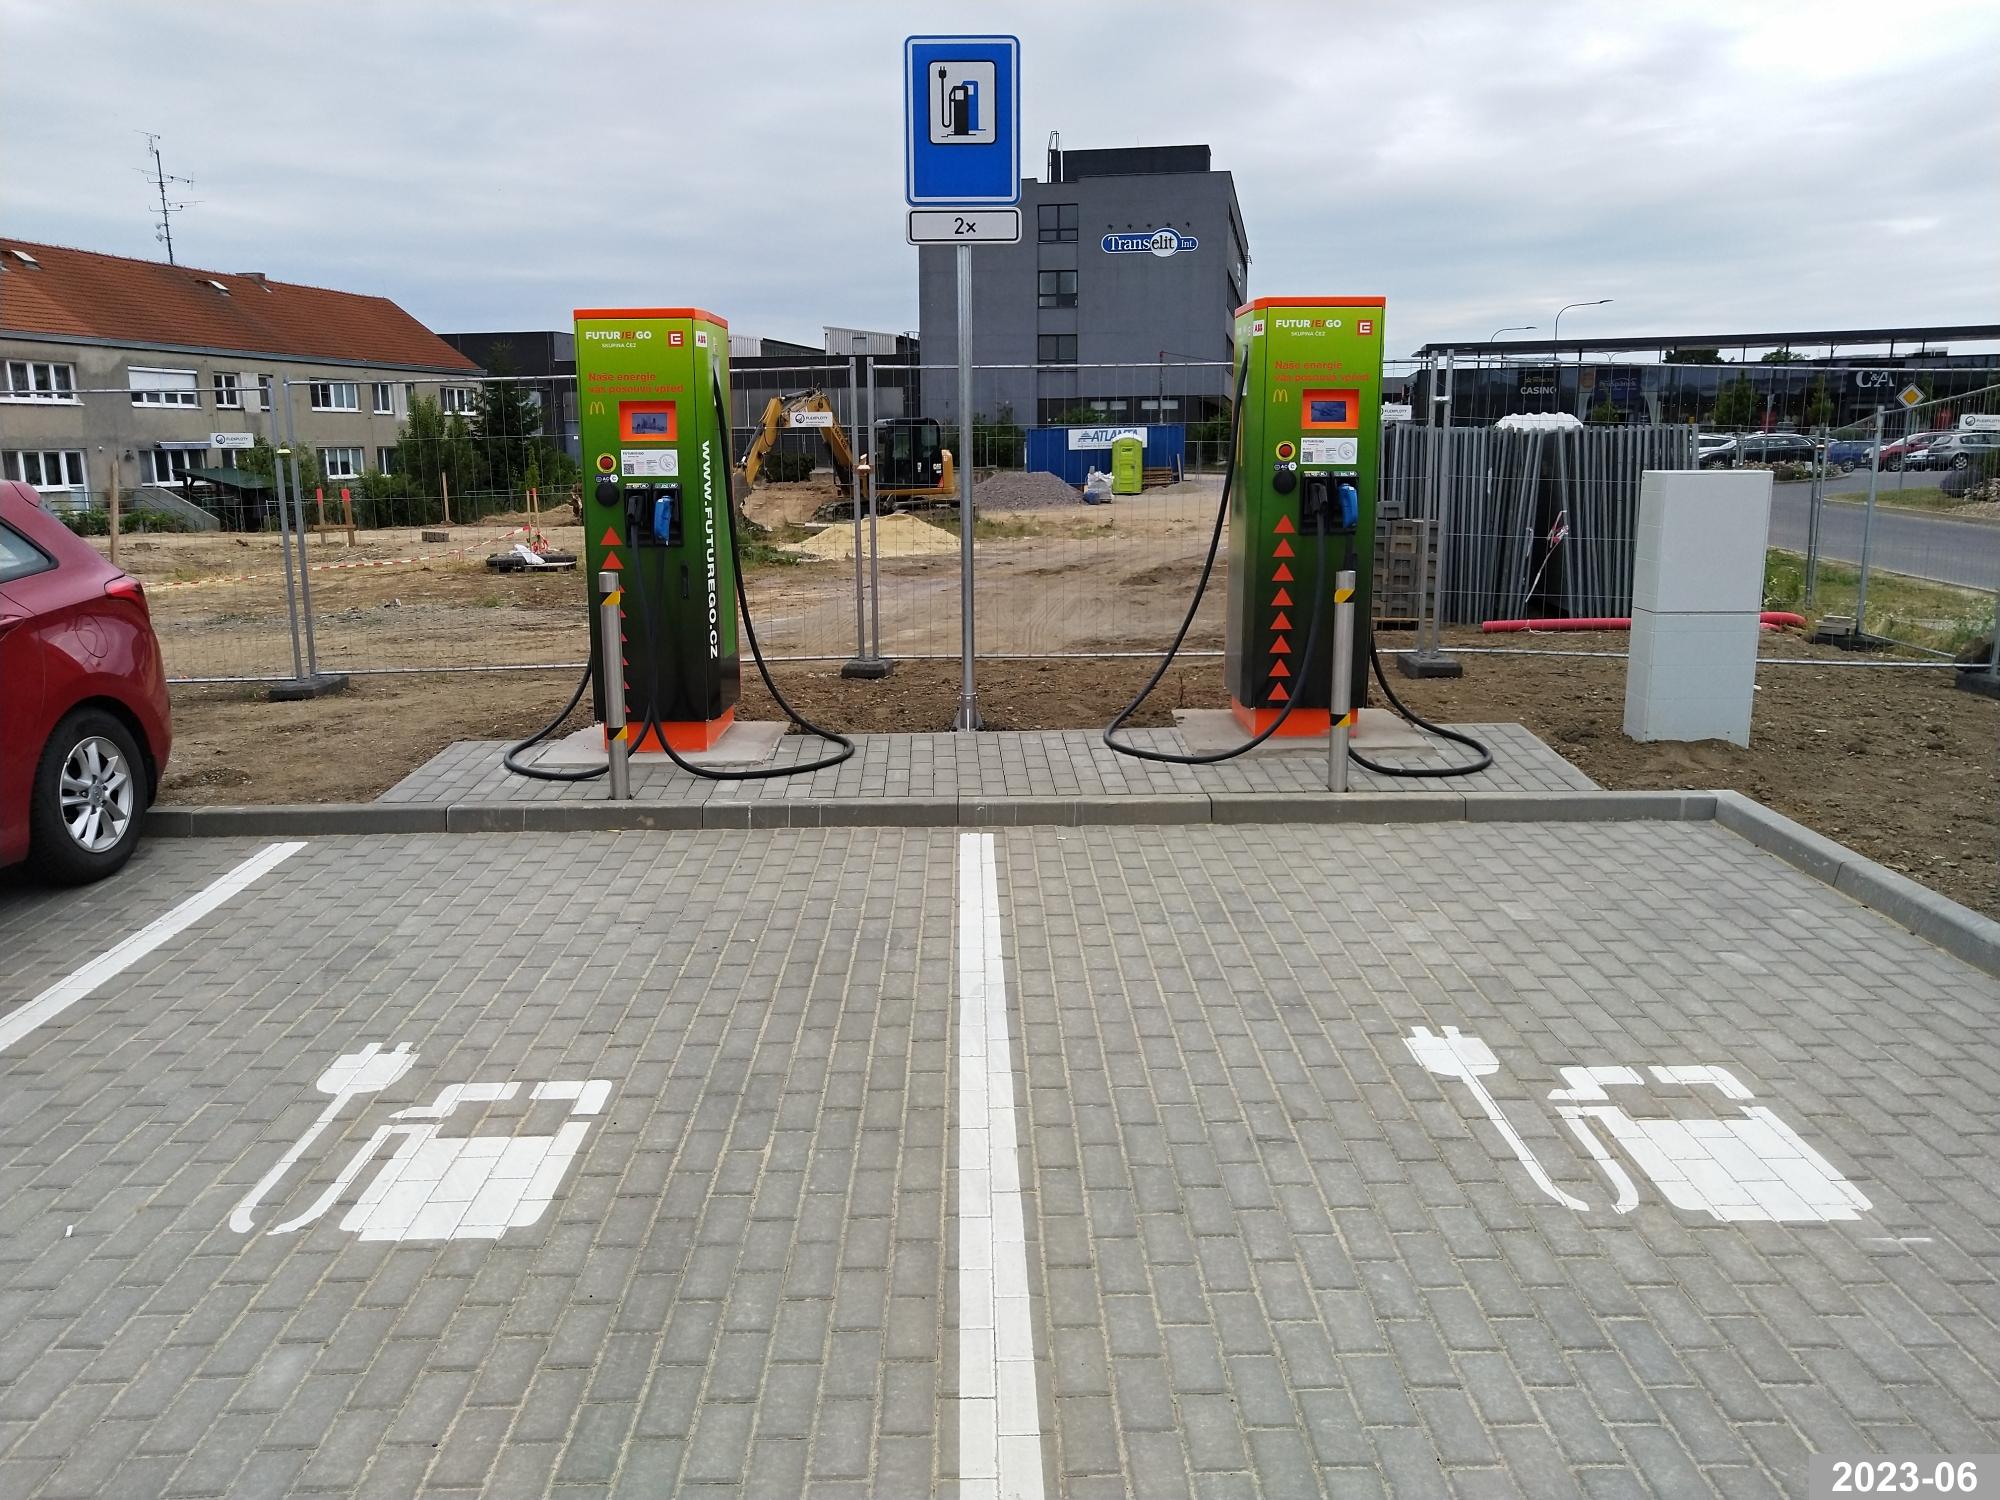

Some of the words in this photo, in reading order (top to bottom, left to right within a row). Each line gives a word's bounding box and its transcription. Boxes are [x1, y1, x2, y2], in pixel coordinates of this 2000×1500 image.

[1108, 235, 1175, 251] Transelit
[1181, 240, 1195, 248] Int.
[1856, 371, 1895, 387] C&A
